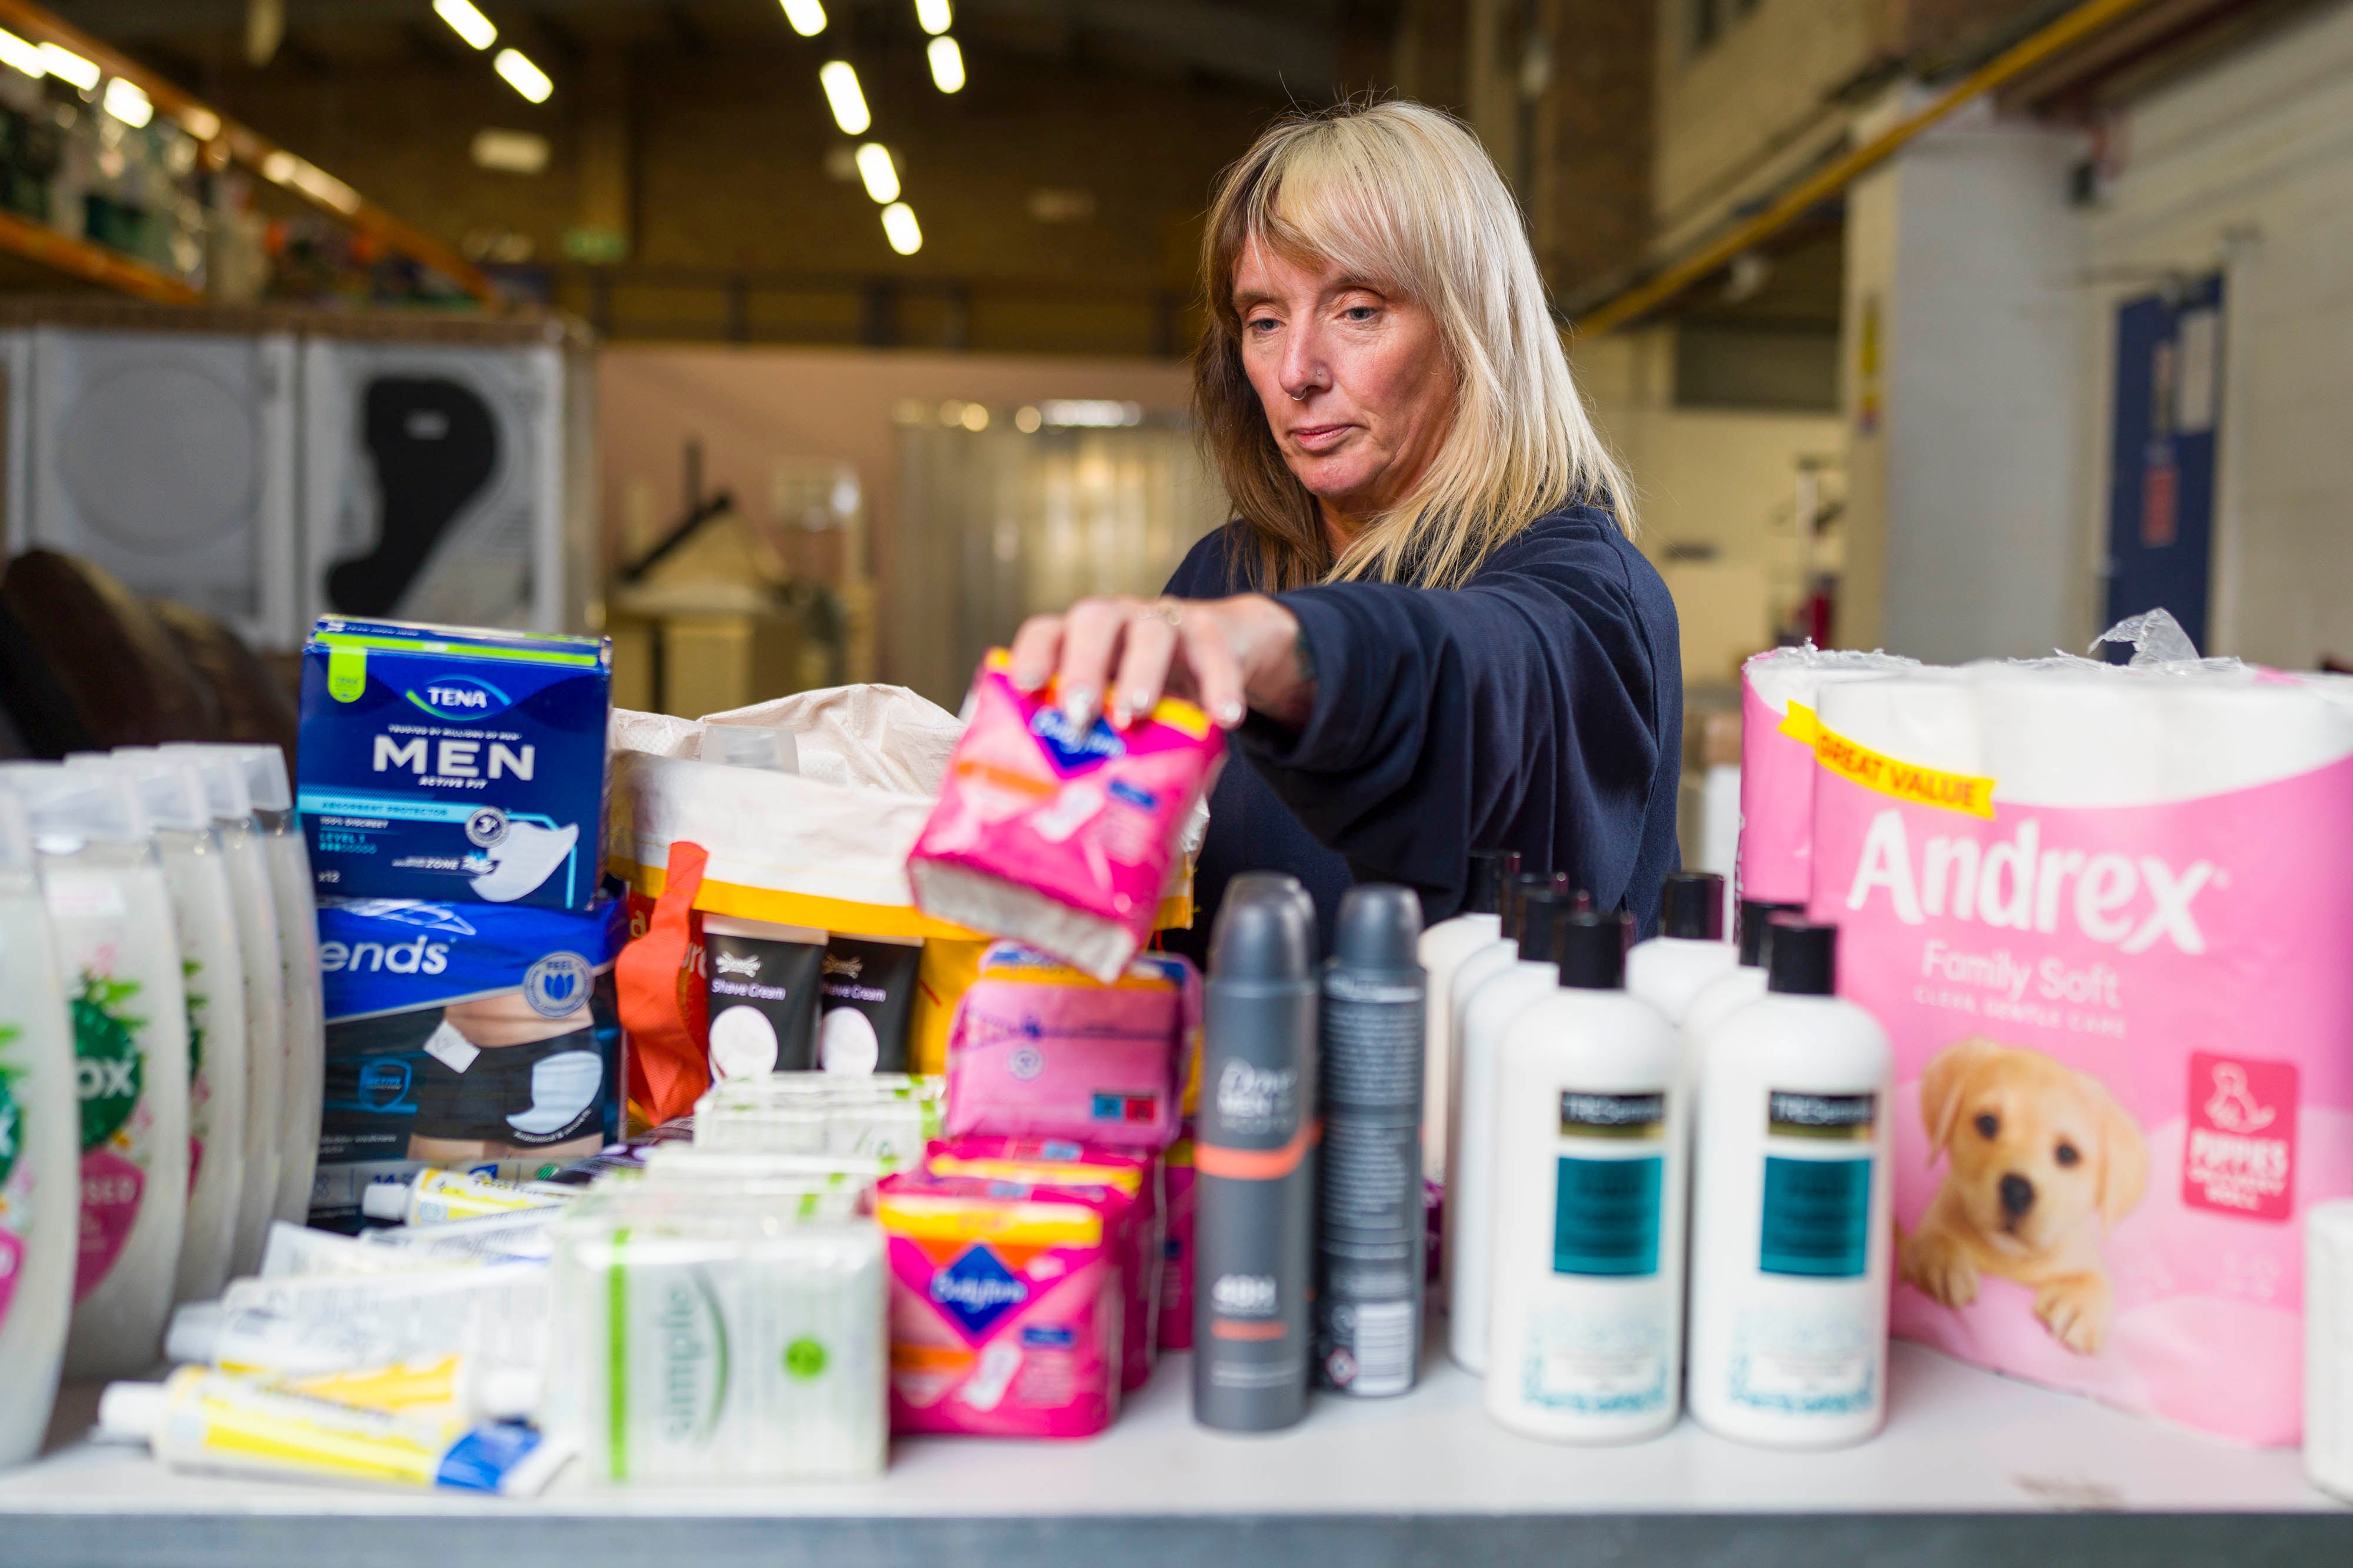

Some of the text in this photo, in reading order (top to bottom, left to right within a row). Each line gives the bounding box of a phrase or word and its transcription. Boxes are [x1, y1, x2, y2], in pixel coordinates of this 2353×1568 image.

[427, 687, 488, 708] TENA
[373, 733, 535, 781] MEN
[1818, 733, 1978, 808] GREAT VALUE
[418, 775, 488, 790] ACTIVE FIT
[387, 805, 449, 816] PROTECTOR
[319, 832, 355, 844] LEVEL
[424, 858, 461, 871] ZONE
[1846, 808, 2217, 956] Andrex
[319, 935, 450, 975] ends
[1921, 938, 2125, 1010] Family Soft
[711, 976, 787, 1002] Shave Cream
[851, 983, 887, 1003] Cream
